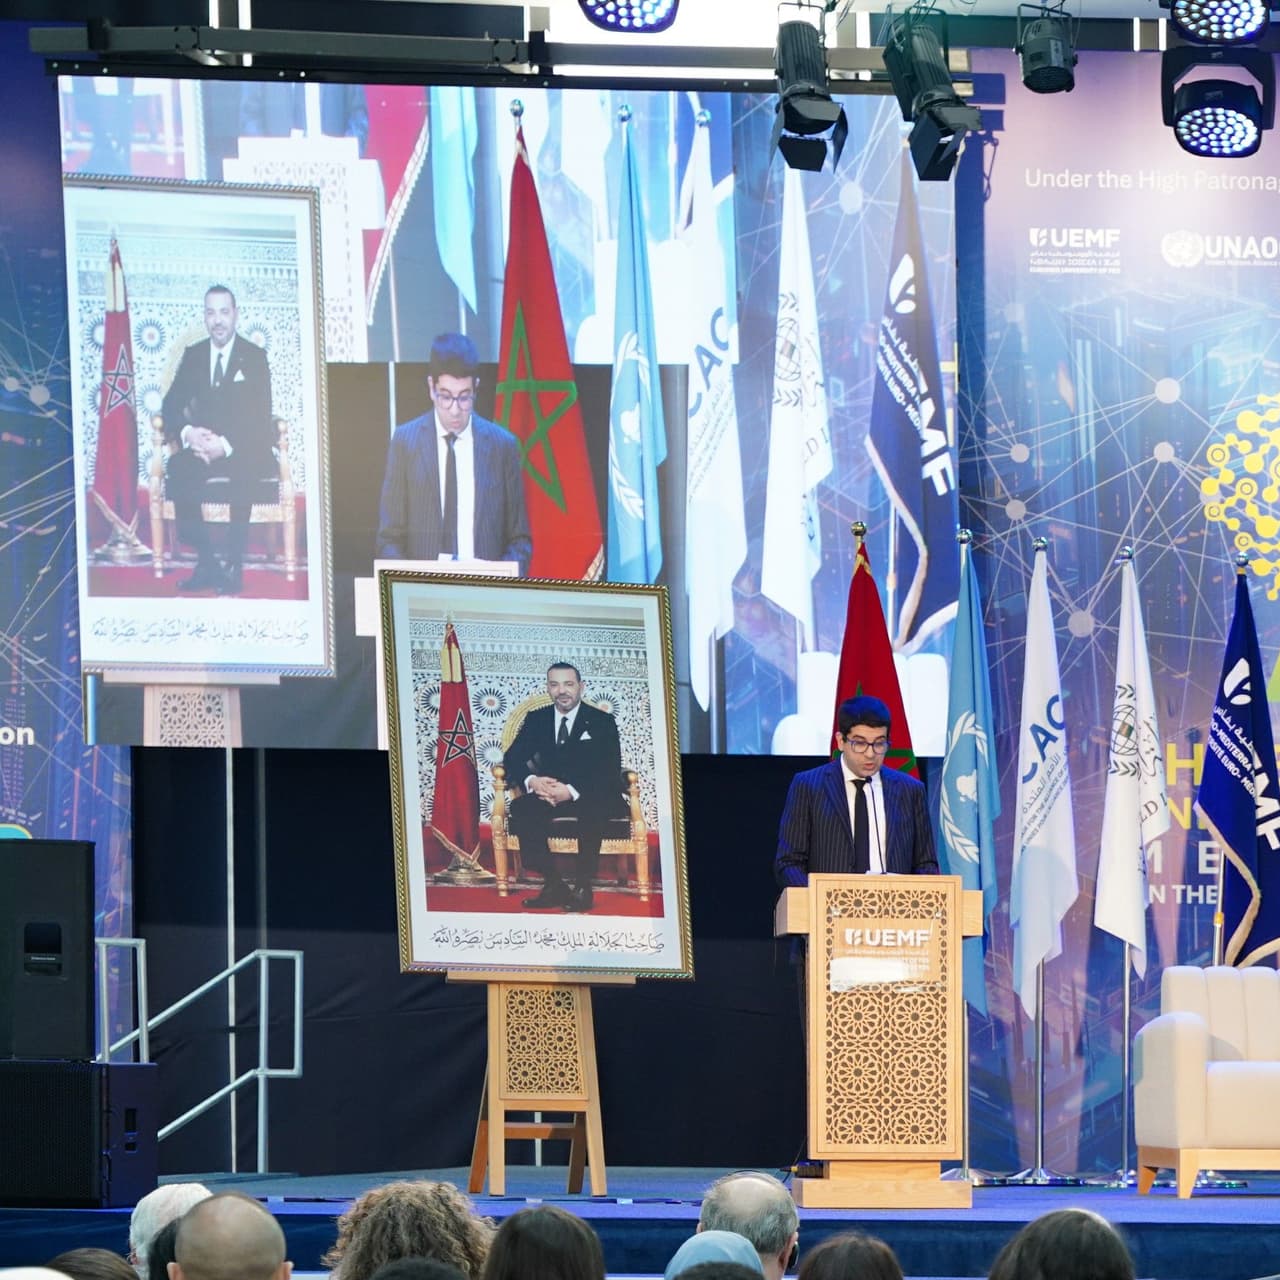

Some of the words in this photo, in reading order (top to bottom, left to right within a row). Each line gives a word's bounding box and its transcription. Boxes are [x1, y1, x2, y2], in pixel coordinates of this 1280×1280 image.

[1025, 168, 1091, 188] Under
[1098, 169, 1133, 189] the
[1139, 170, 1188, 194] High
[1051, 228, 1121, 248] UEMF
[1172, 888, 1218, 905] THE
[865, 928, 931, 948] UEMF
